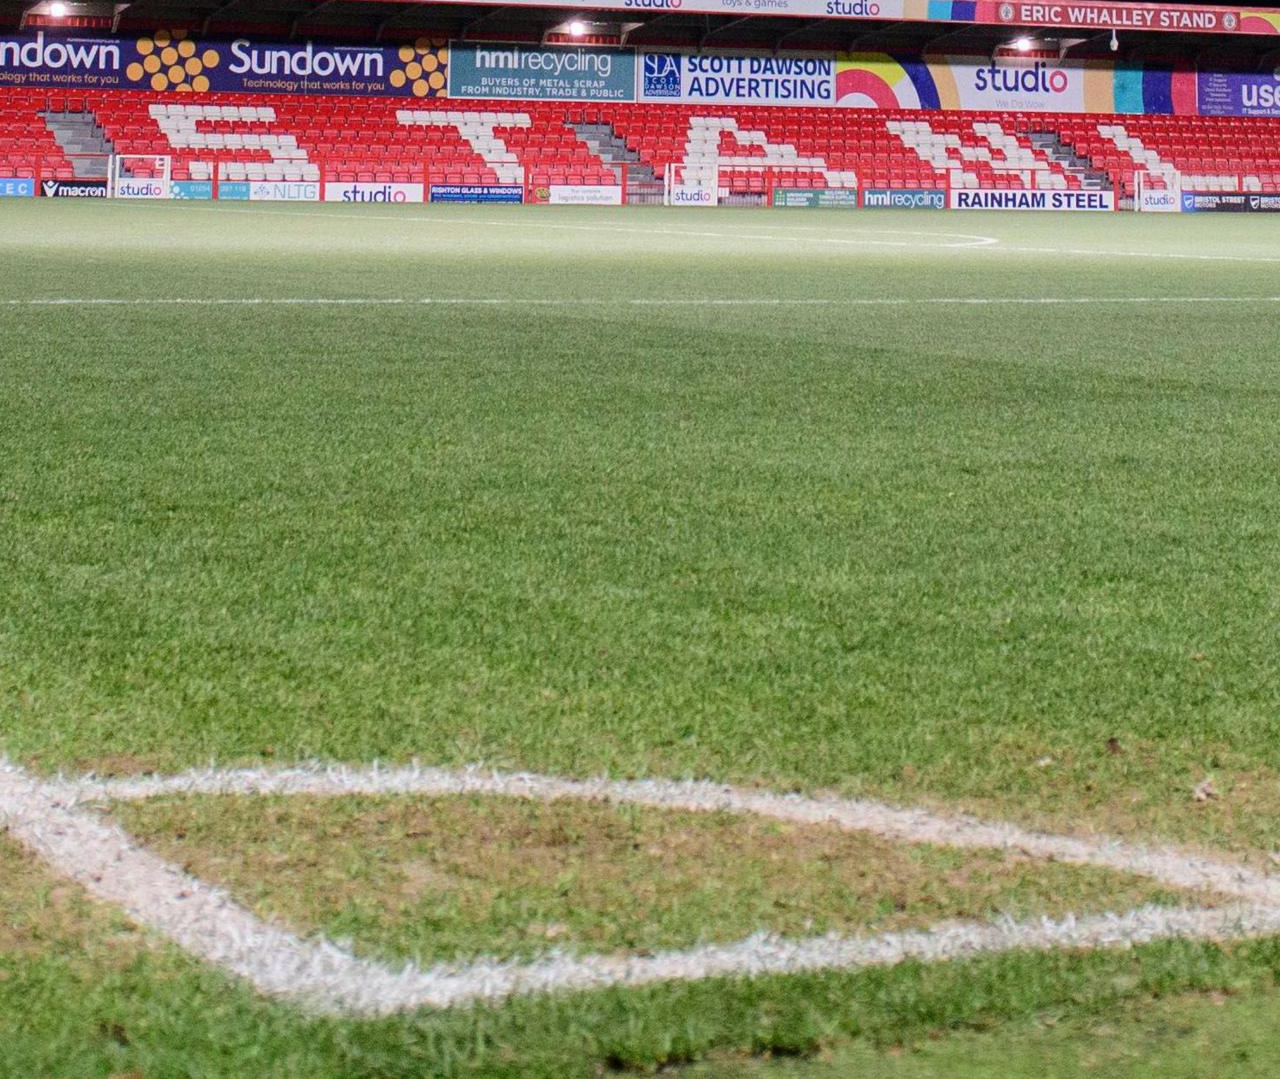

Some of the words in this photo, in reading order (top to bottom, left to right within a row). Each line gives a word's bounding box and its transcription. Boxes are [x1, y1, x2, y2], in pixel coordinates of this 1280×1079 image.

[1021, 5, 1062, 22] ERIC
[1069, 7, 1154, 26] WHALLEY
[1160, 12, 1216, 29] STAND
[228, 39, 383, 77] Sundown
[688, 55, 745, 74] SCOTT
[750, 57, 831, 76] DAWSON
[29, 72, 50, 82] that
[52, 74, 82, 83] works
[84, 73, 97, 83] for
[100, 76, 119, 86] you
[481, 77, 519, 86] BUYERS
[523, 78, 535, 87] OF
[539, 78, 571, 87] METAL
[574, 80, 605, 88] SCRAP
[975, 60, 1068, 93] studio
[242, 78, 299, 91] Technology
[300, 79, 321, 89] that
[323, 81, 350, 90] works
[352, 81, 365, 90] for
[366, 82, 385, 92] you
[461, 85, 489, 94] FROM
[492, 86, 543, 97] INDUSTRY,
[546, 87, 577, 96] TRADE
[581, 88, 588, 97] &
[590, 89, 624, 98] PUBLIC
[688, 77, 831, 99] ADVERTISING
[645, 89, 681, 97] ADVERTISING
[995, 99, 1009, 108] We
[58, 185, 106, 197] macron
[120, 182, 162, 197] studio
[273, 184, 316, 199] NLTG
[343, 185, 407, 203] studio
[489, 187, 523, 195] WINDOWS
[675, 186, 711, 201] studio
[958, 191, 1046, 208] RAINHAM
[1053, 192, 1108, 209] STEEL
[1144, 193, 1175, 206] studio
